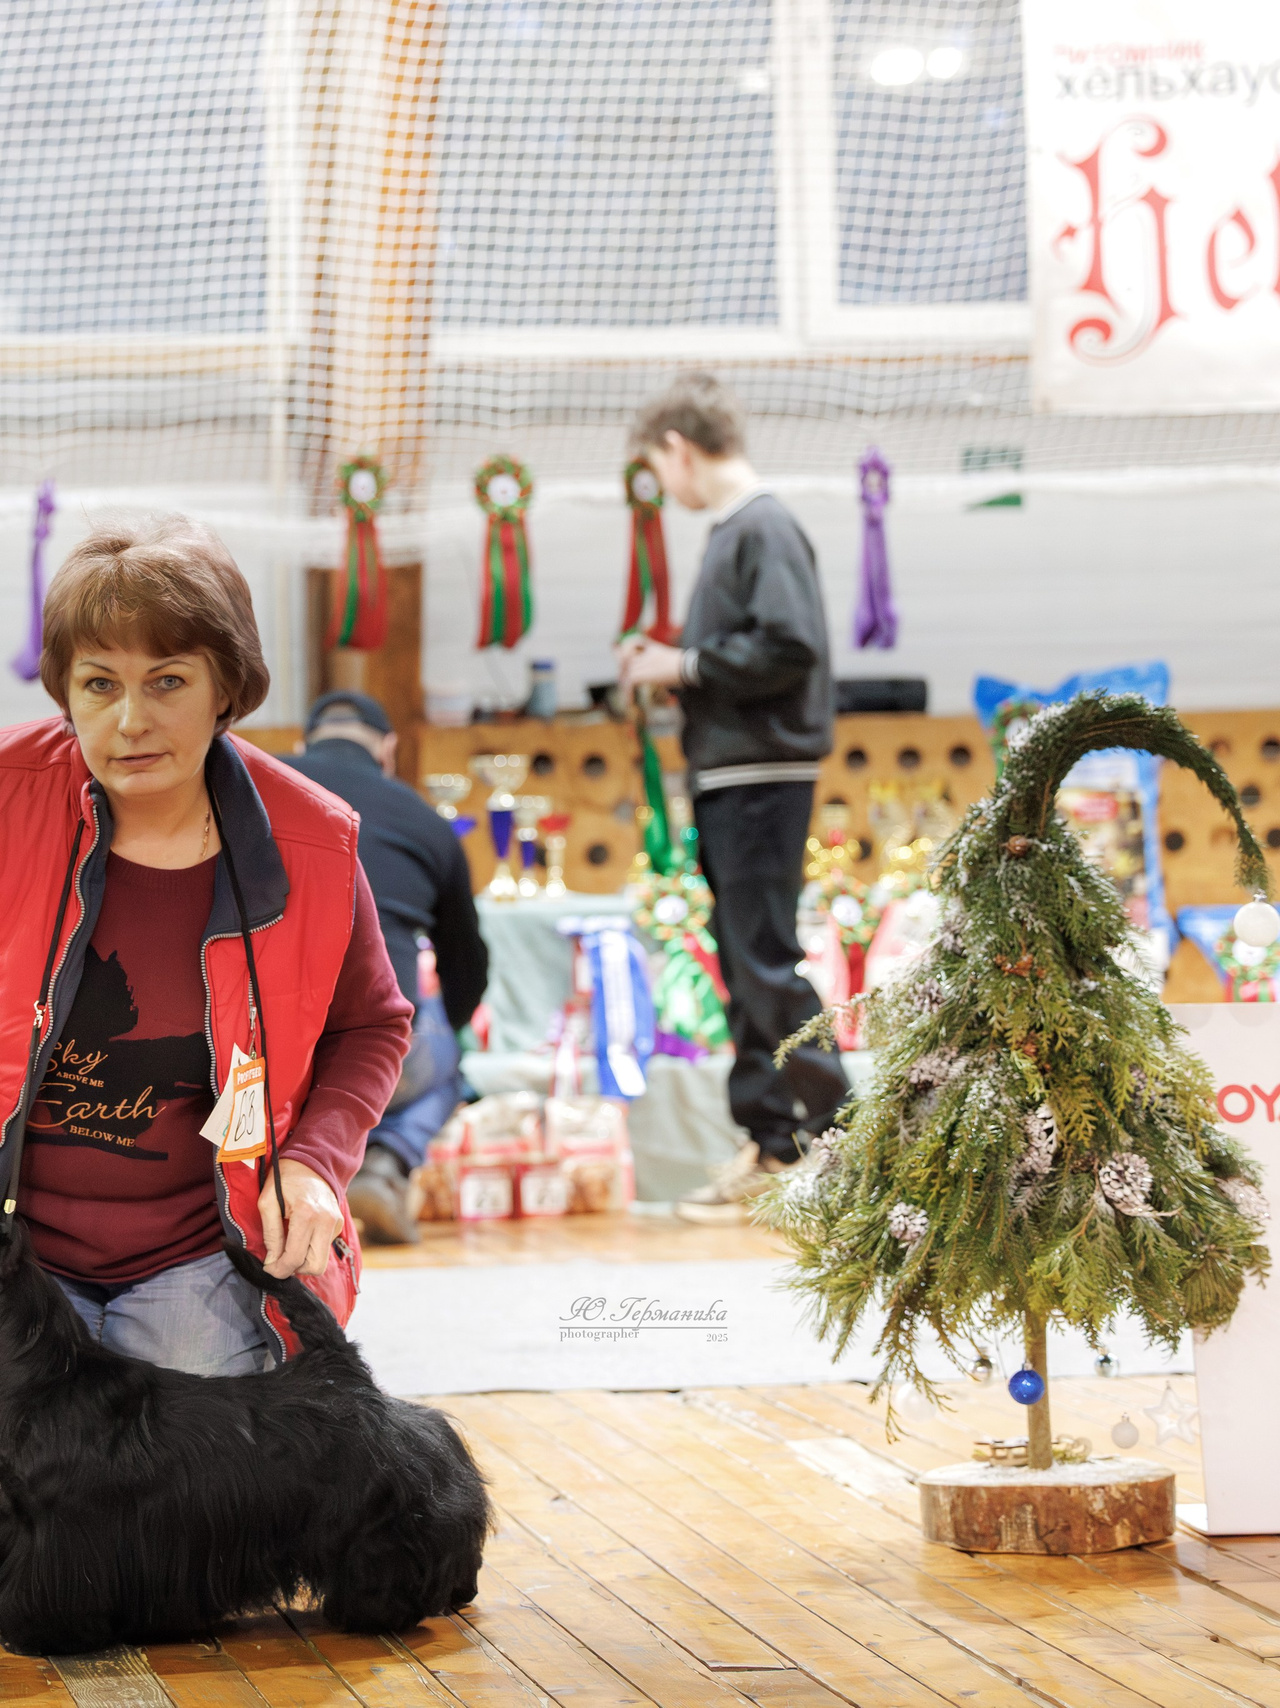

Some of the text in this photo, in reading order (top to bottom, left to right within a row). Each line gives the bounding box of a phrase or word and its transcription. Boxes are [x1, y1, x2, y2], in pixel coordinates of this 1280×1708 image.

[56, 1071, 105, 1088] ABOVE ME
[69, 1124, 135, 1147] BELOW ME
